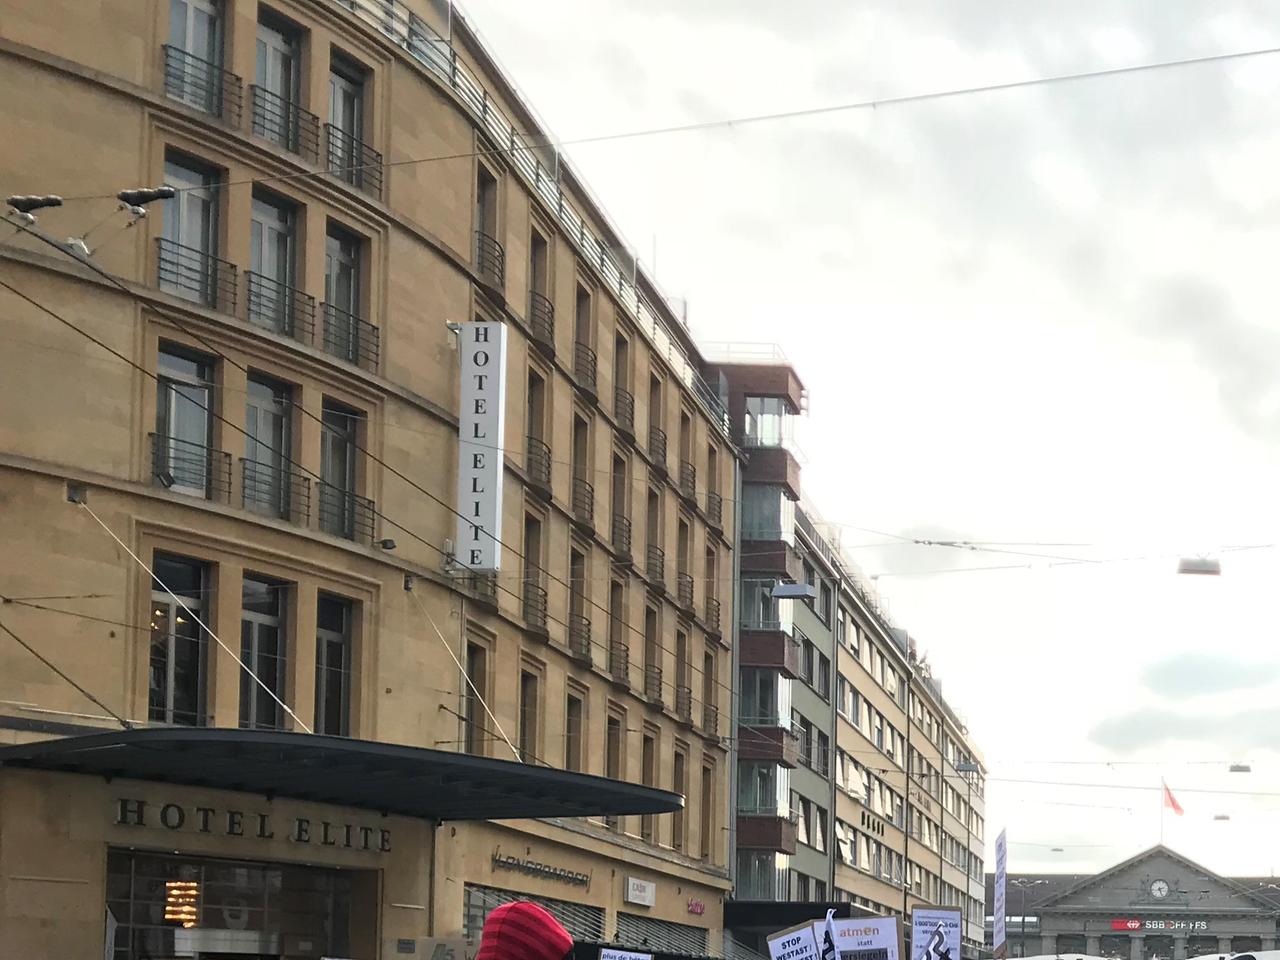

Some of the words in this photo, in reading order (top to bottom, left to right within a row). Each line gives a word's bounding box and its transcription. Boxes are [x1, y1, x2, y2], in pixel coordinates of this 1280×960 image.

[472, 326, 490, 439] HOTEL
[469, 453, 486, 565] ELITE
[114, 798, 274, 839] HOTEL
[294, 817, 392, 852] ELITE
[1145, 920, 1165, 929] SBB
[839, 927, 880, 938] atmen
[781, 936, 802, 950] STOP
[602, 952, 617, 960] plus
